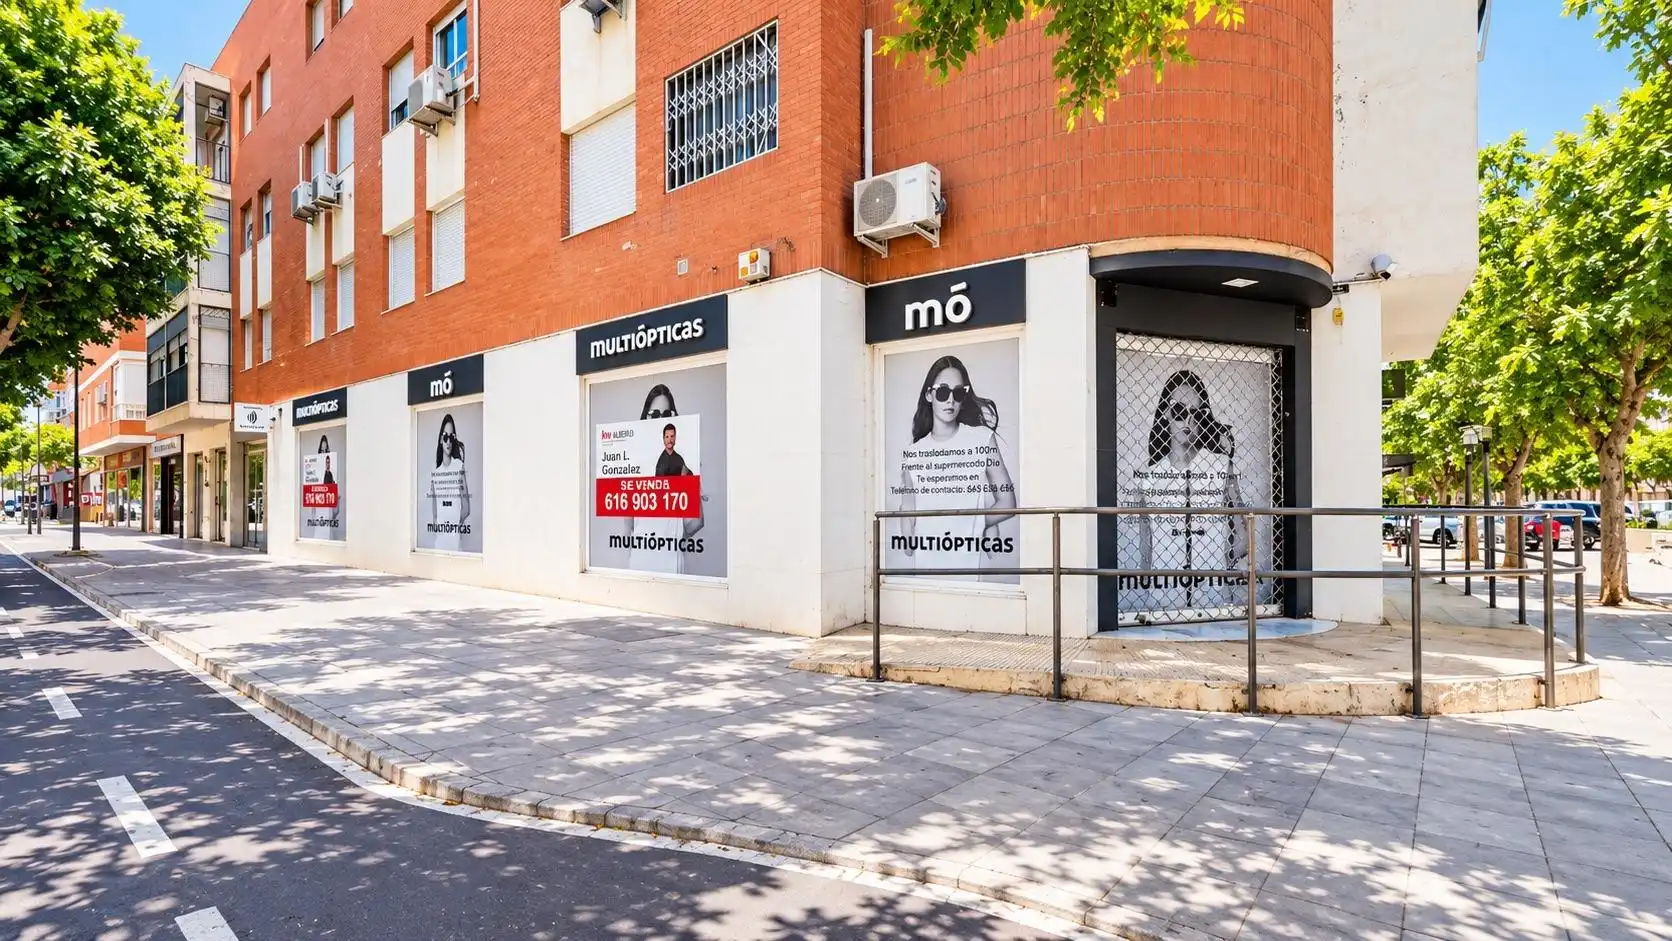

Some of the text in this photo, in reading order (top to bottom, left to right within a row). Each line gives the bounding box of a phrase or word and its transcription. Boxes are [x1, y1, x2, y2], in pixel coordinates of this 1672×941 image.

[905, 281, 972, 330] mó
[430, 370, 452, 397] mó
[601, 450, 630, 462] Juan L.
[601, 463, 641, 475] Gonzalez
[620, 480, 635, 491] SE
[604, 491, 689, 511] 616 903 170
